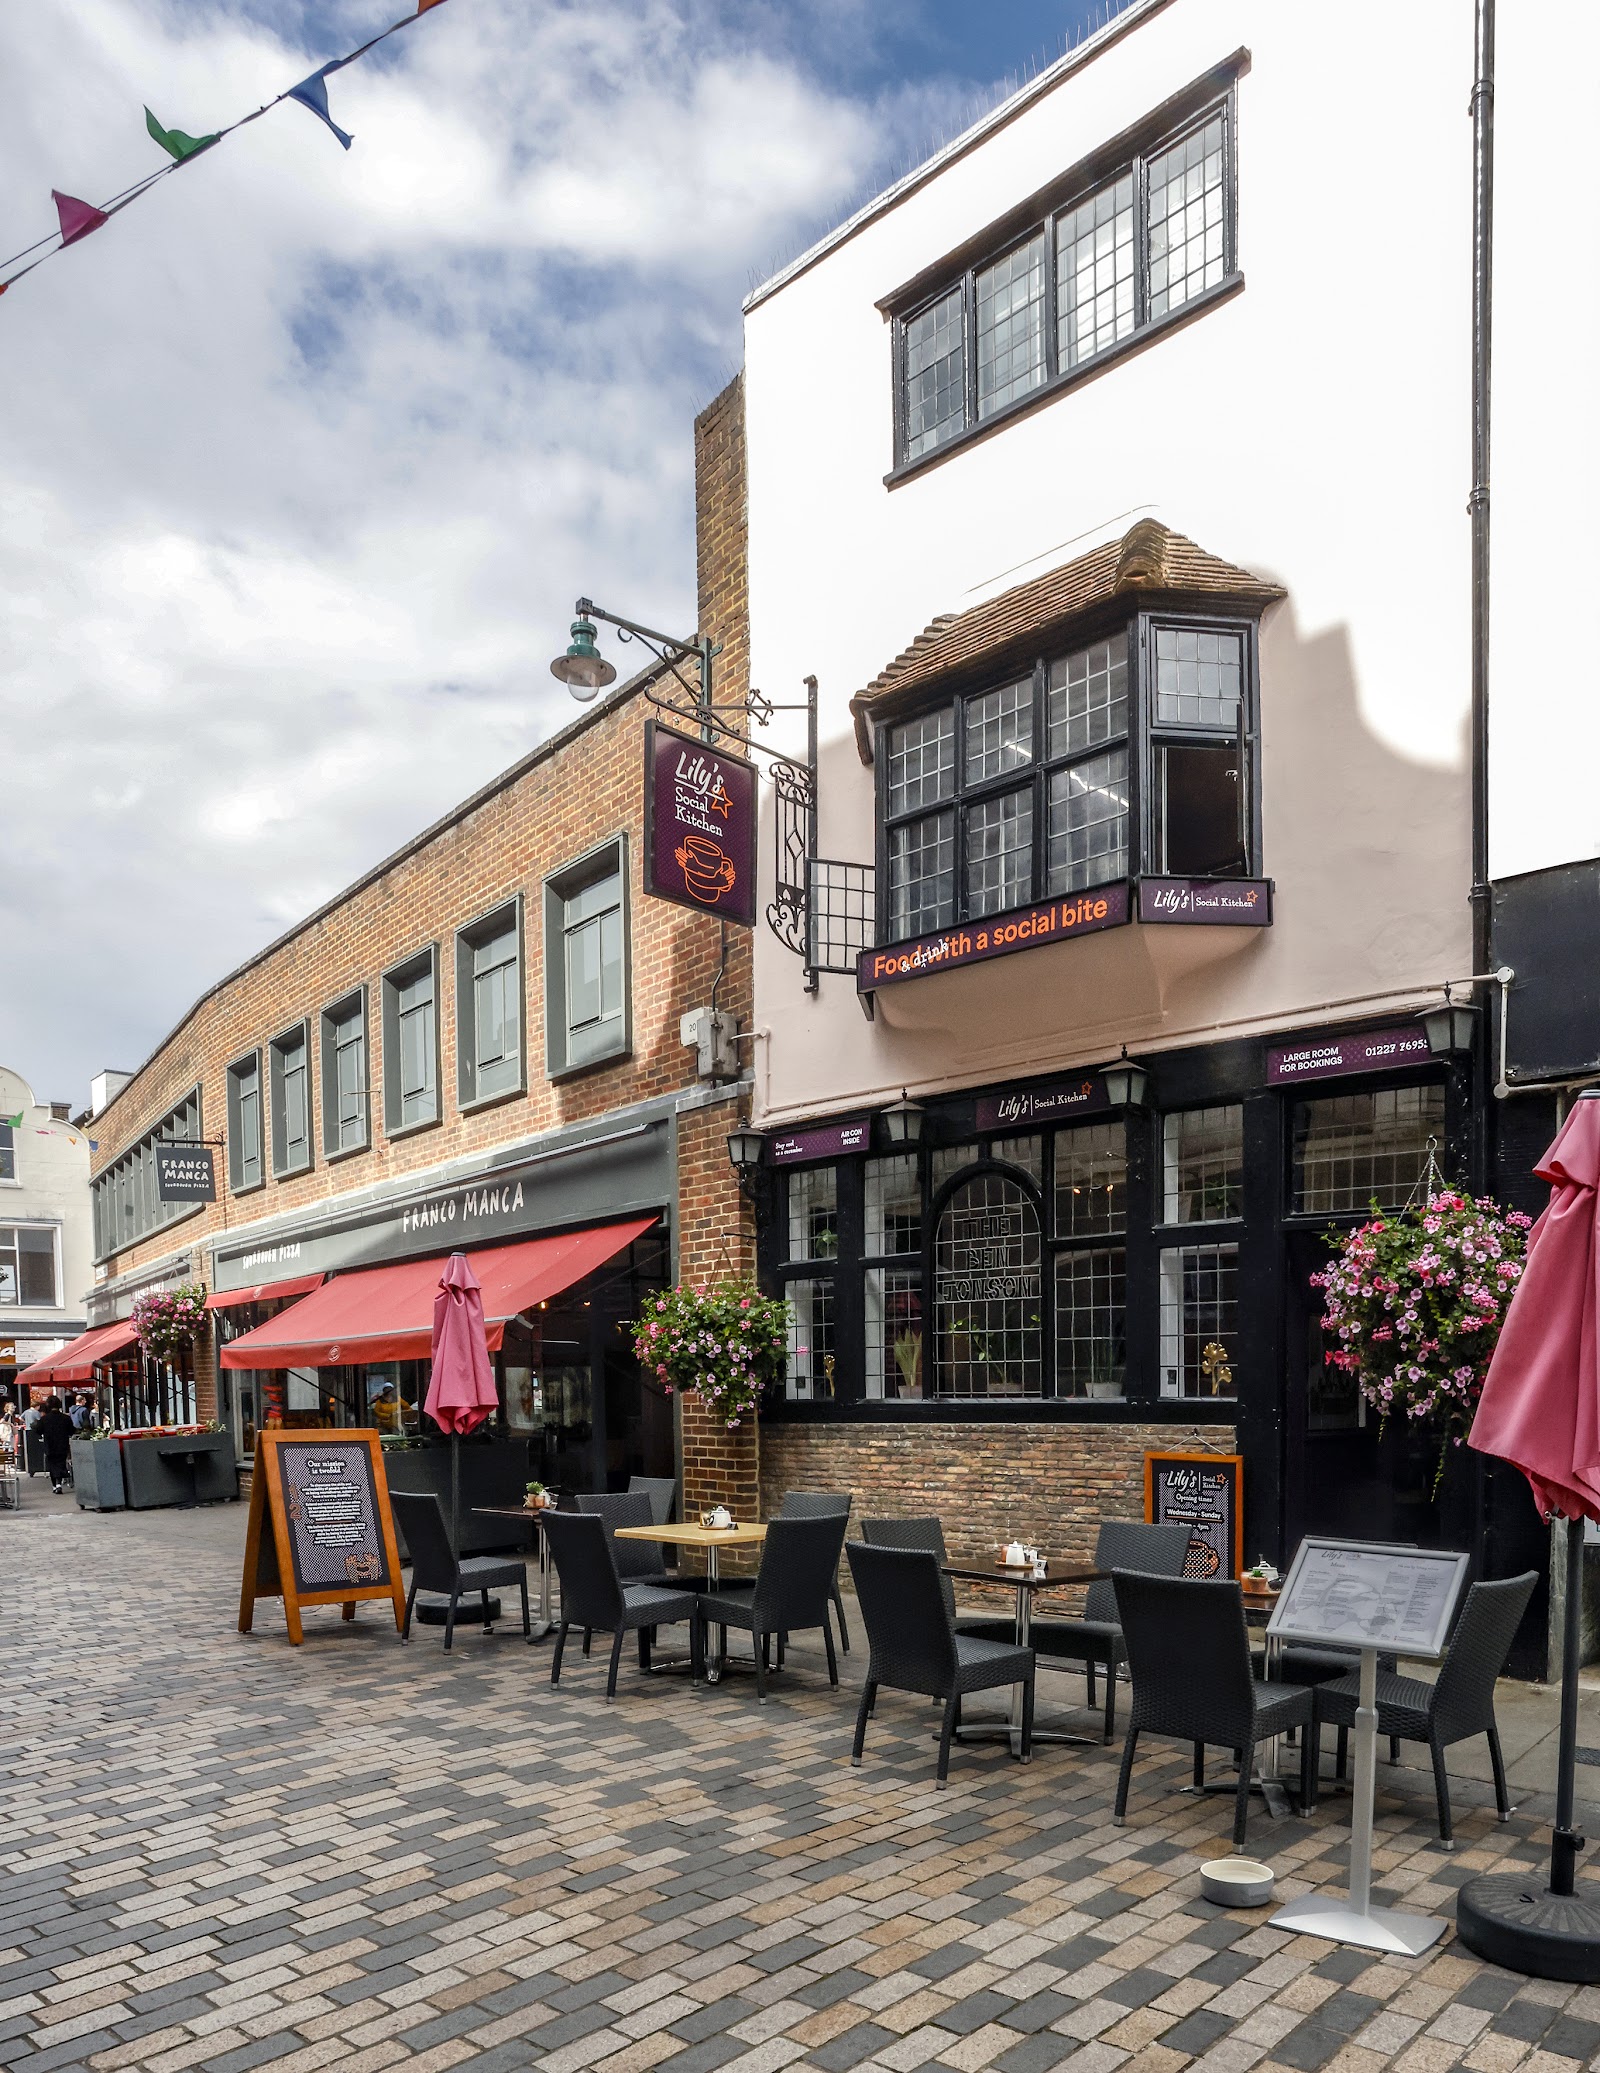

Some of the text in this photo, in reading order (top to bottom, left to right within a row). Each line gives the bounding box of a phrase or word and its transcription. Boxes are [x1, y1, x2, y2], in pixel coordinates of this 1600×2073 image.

[676, 751, 724, 795] Lily's
[675, 786, 710, 814] Social
[675, 803, 724, 837] Kitchen
[1154, 889, 1253, 914] Lily's Social Kitchen
[874, 944, 922, 978] Food
[976, 933, 988, 950] a
[993, 907, 1056, 945] social
[1062, 898, 1108, 928] bite
[901, 938, 949, 973] & drink
[1279, 1056, 1343, 1073] FOR BOOKINGS
[1283, 1051, 1311, 1063] LARGE
[1312, 1046, 1339, 1058] ROOM
[998, 1091, 1088, 1121] Lily's Social Kitchen
[841, 1128, 863, 1138] AIR CON
[843, 1136, 861, 1145] INSIDE
[161, 1159, 209, 1169] FRANCO
[164, 1169, 209, 1180] MANCA
[403, 1182, 524, 1233] FRANCO MANCA
[962, 1216, 1011, 1240] THE
[279, 1242, 300, 1263] PIZZA
[966, 1248, 1010, 1270] BEN
[943, 1277, 1032, 1301] JONSON
[307, 1460, 321, 1468] Our
[1167, 1469, 1197, 1492] Lily's
[1176, 1493, 1213, 1503] Opening times
[289, 1503, 301, 1518] 2
[1166, 1508, 1198, 1517] Wednesday
[1201, 1511, 1221, 1520] Sunday
